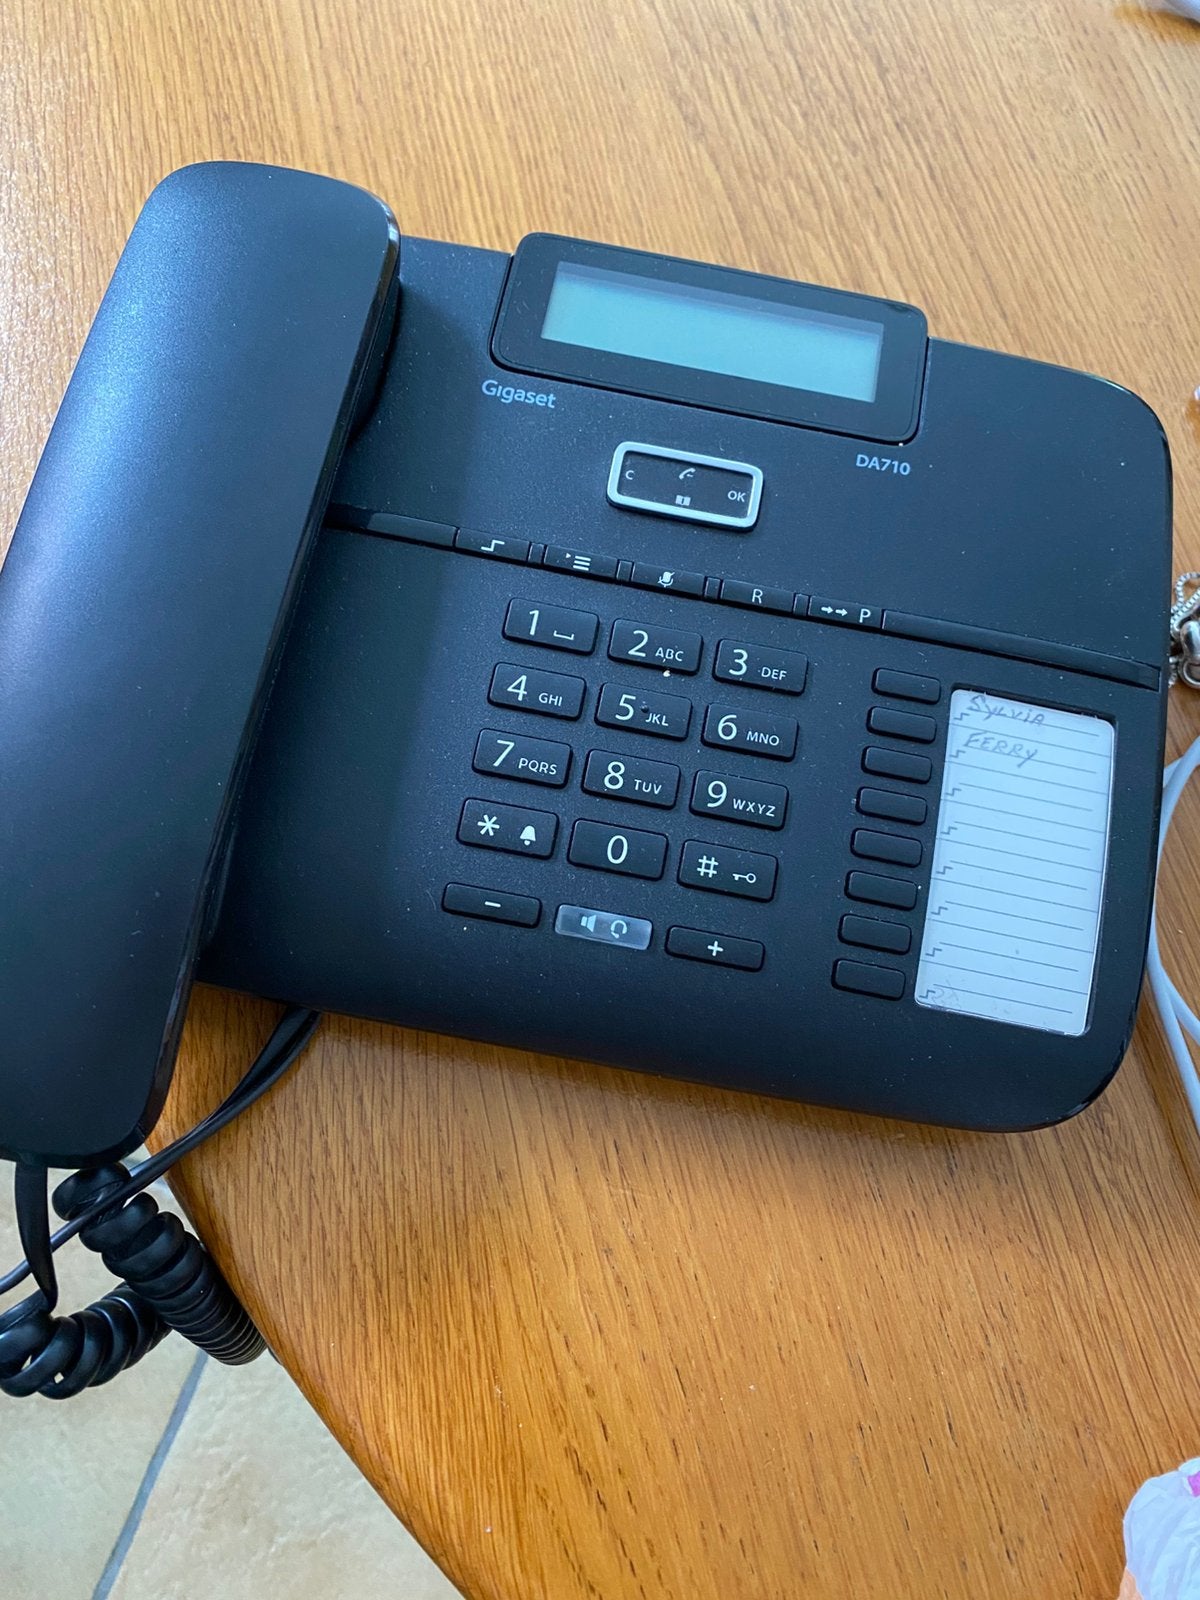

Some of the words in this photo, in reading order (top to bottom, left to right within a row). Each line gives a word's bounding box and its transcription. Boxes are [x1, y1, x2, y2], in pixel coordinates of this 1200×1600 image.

[481, 379, 557, 409] Gigaset
[625, 469, 635, 481] C
[855, 454, 911, 476] DA710
[727, 490, 746, 503] OK
[751, 588, 764, 604] R
[529, 609, 540, 636] 1
[859, 608, 872, 623] P
[627, 629, 649, 658] 2
[655, 647, 684, 663] ABC
[728, 648, 748, 676] 3
[761, 666, 787, 681] DEF
[506, 674, 528, 702] 4
[538, 692, 563, 707] GHI
[615, 693, 637, 721] 5
[645, 712, 669, 727] JKL
[717, 714, 737, 741] 6
[746, 730, 780, 746] MNO
[493, 739, 515, 767] 7
[518, 757, 557, 775] PQRS
[603, 761, 626, 790] 8
[634, 778, 662, 795] TUV
[707, 780, 728, 808] 9
[733, 798, 776, 817] WXYZ
[606, 834, 628, 864] 0
